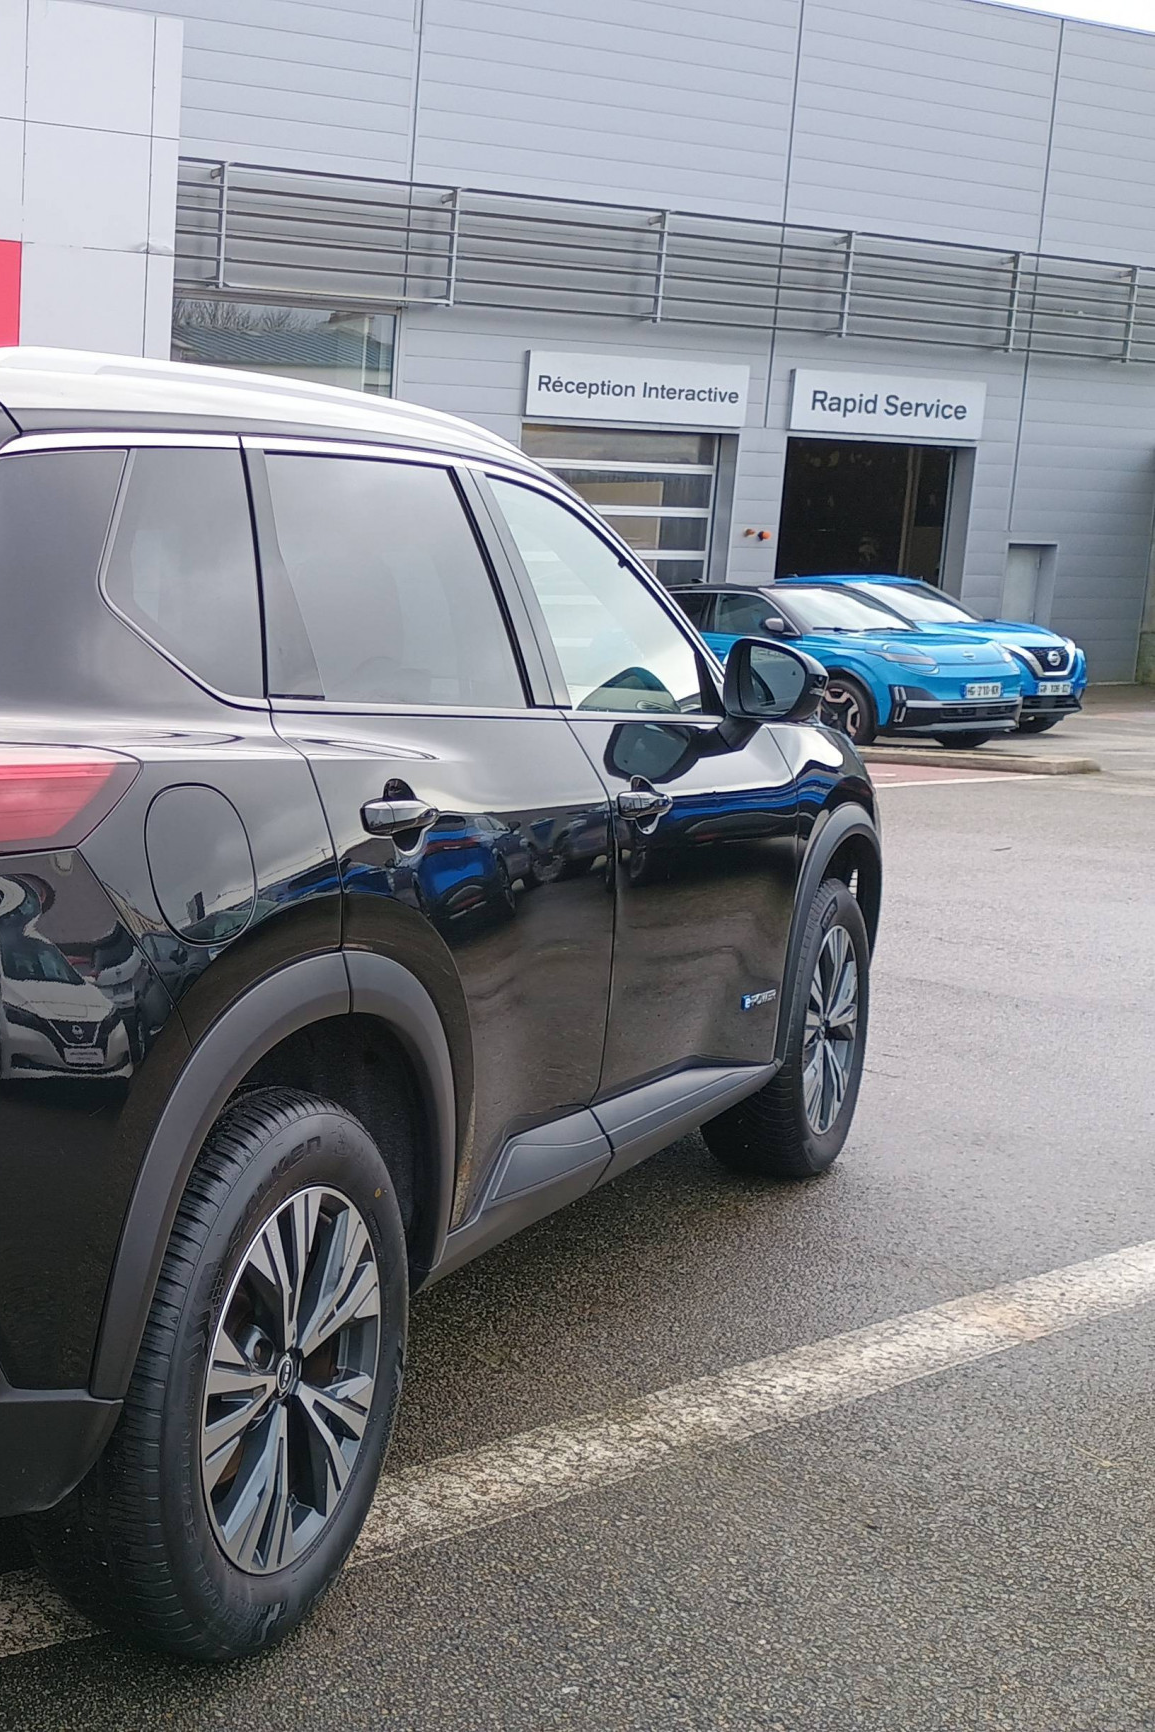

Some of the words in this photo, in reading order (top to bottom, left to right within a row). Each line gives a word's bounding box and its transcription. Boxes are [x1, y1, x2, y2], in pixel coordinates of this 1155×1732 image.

[537, 374, 636, 399] Réception
[642, 382, 739, 404] Interactive
[811, 390, 878, 418] Rapid
[884, 395, 967, 420] Service
